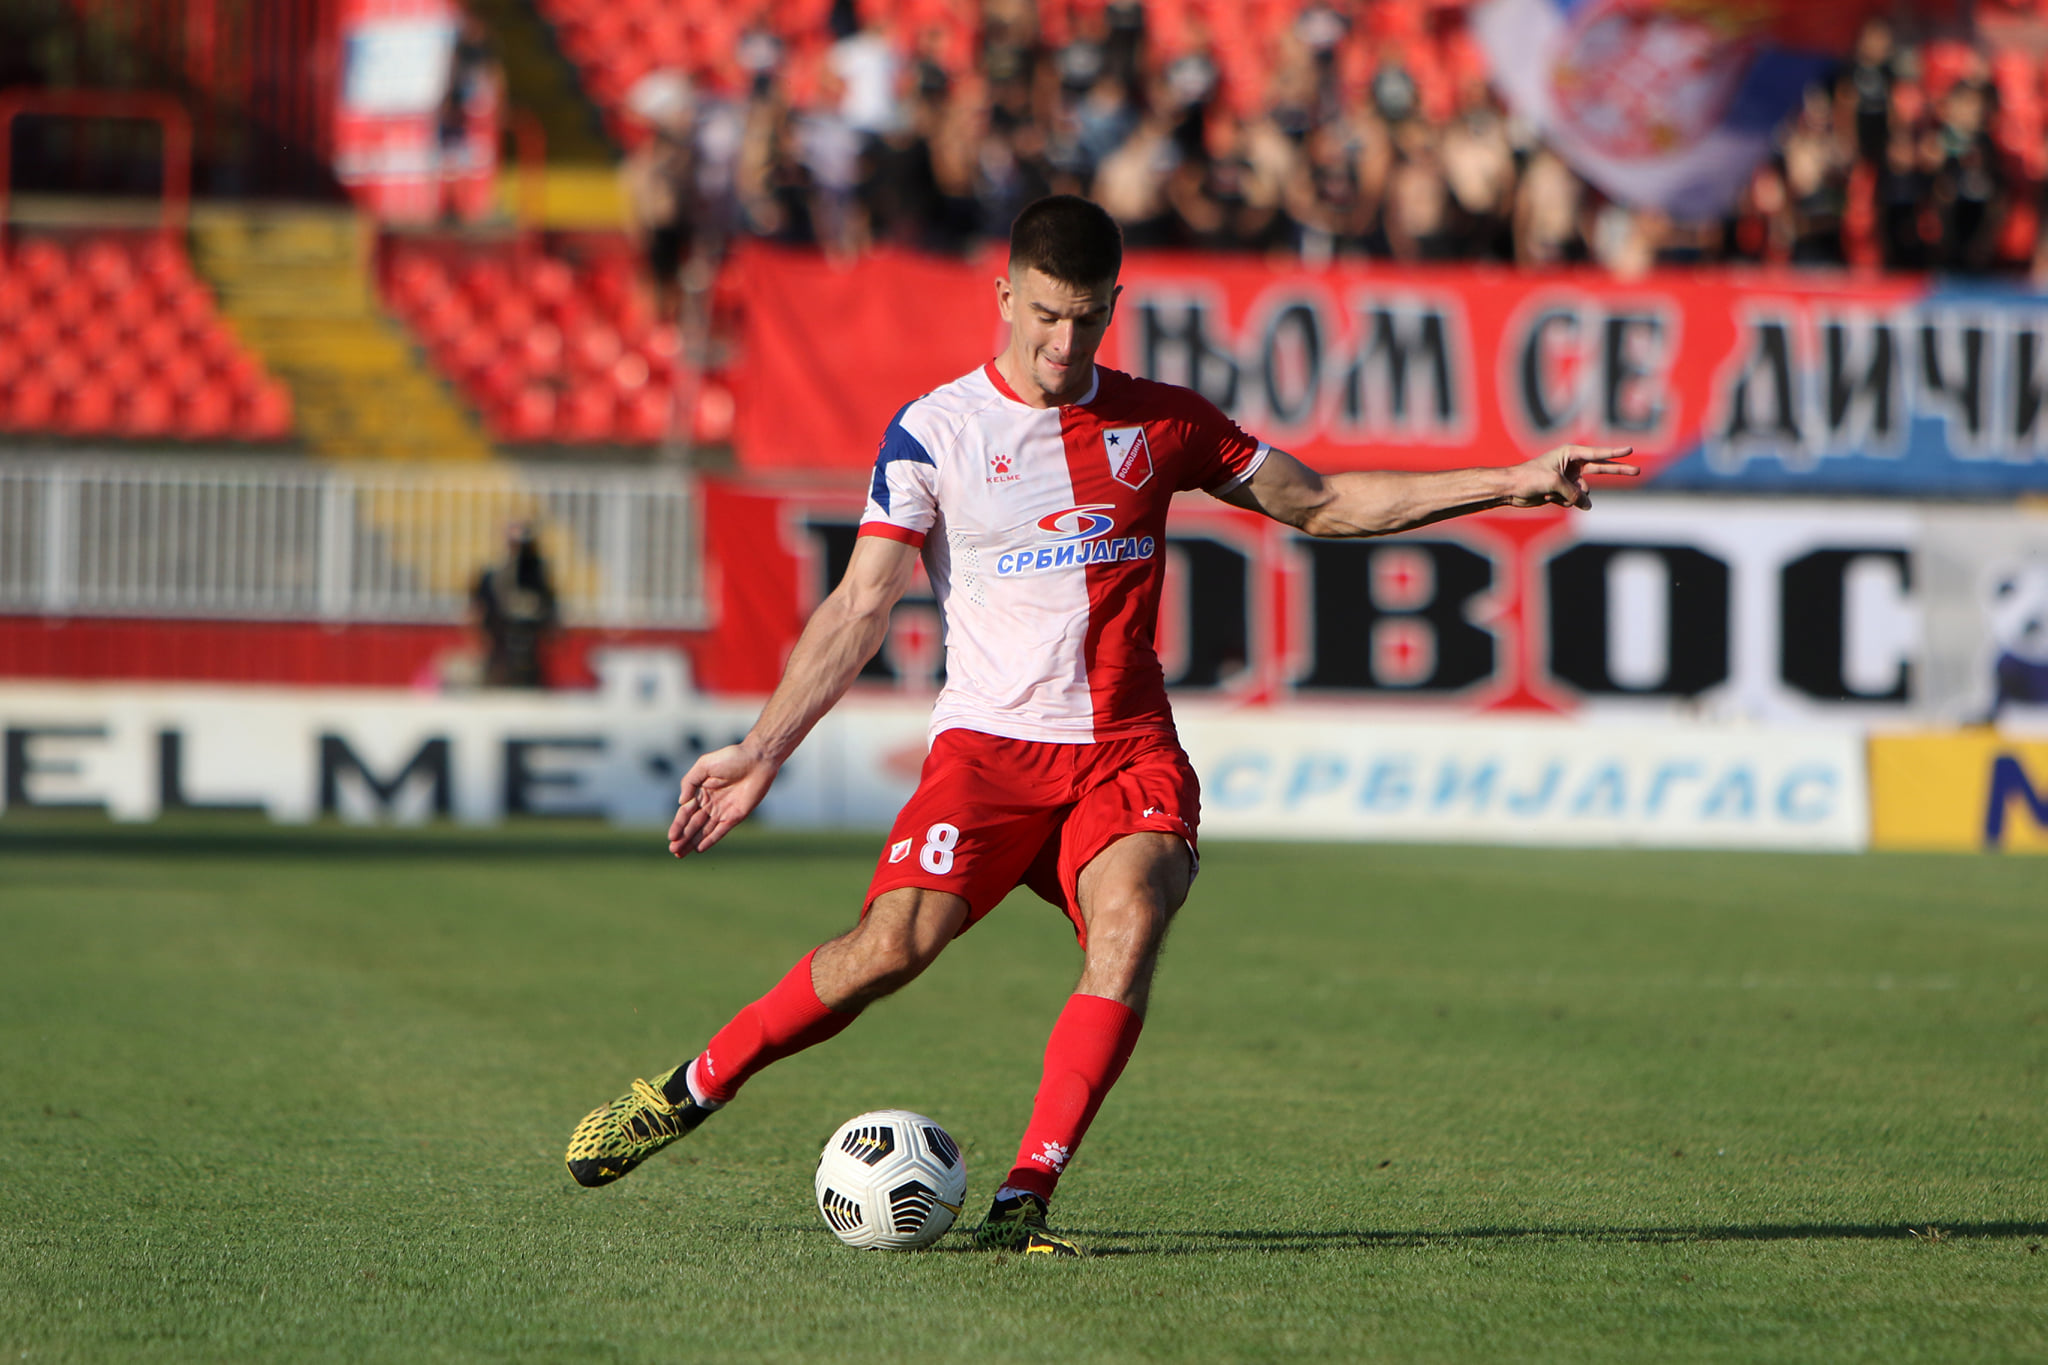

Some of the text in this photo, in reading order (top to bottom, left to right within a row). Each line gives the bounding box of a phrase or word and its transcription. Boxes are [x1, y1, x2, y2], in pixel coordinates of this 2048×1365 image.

[1510, 303, 1672, 438] СЕ
[986, 474, 1021, 483] KELME
[1118, 438, 1144, 479] ВОЈВОДИНА
[996, 536, 1156, 577] СРБИЈАГАС
[1207, 750, 1842, 827] СРБИЈАГАС
[919, 823, 960, 875] 8
